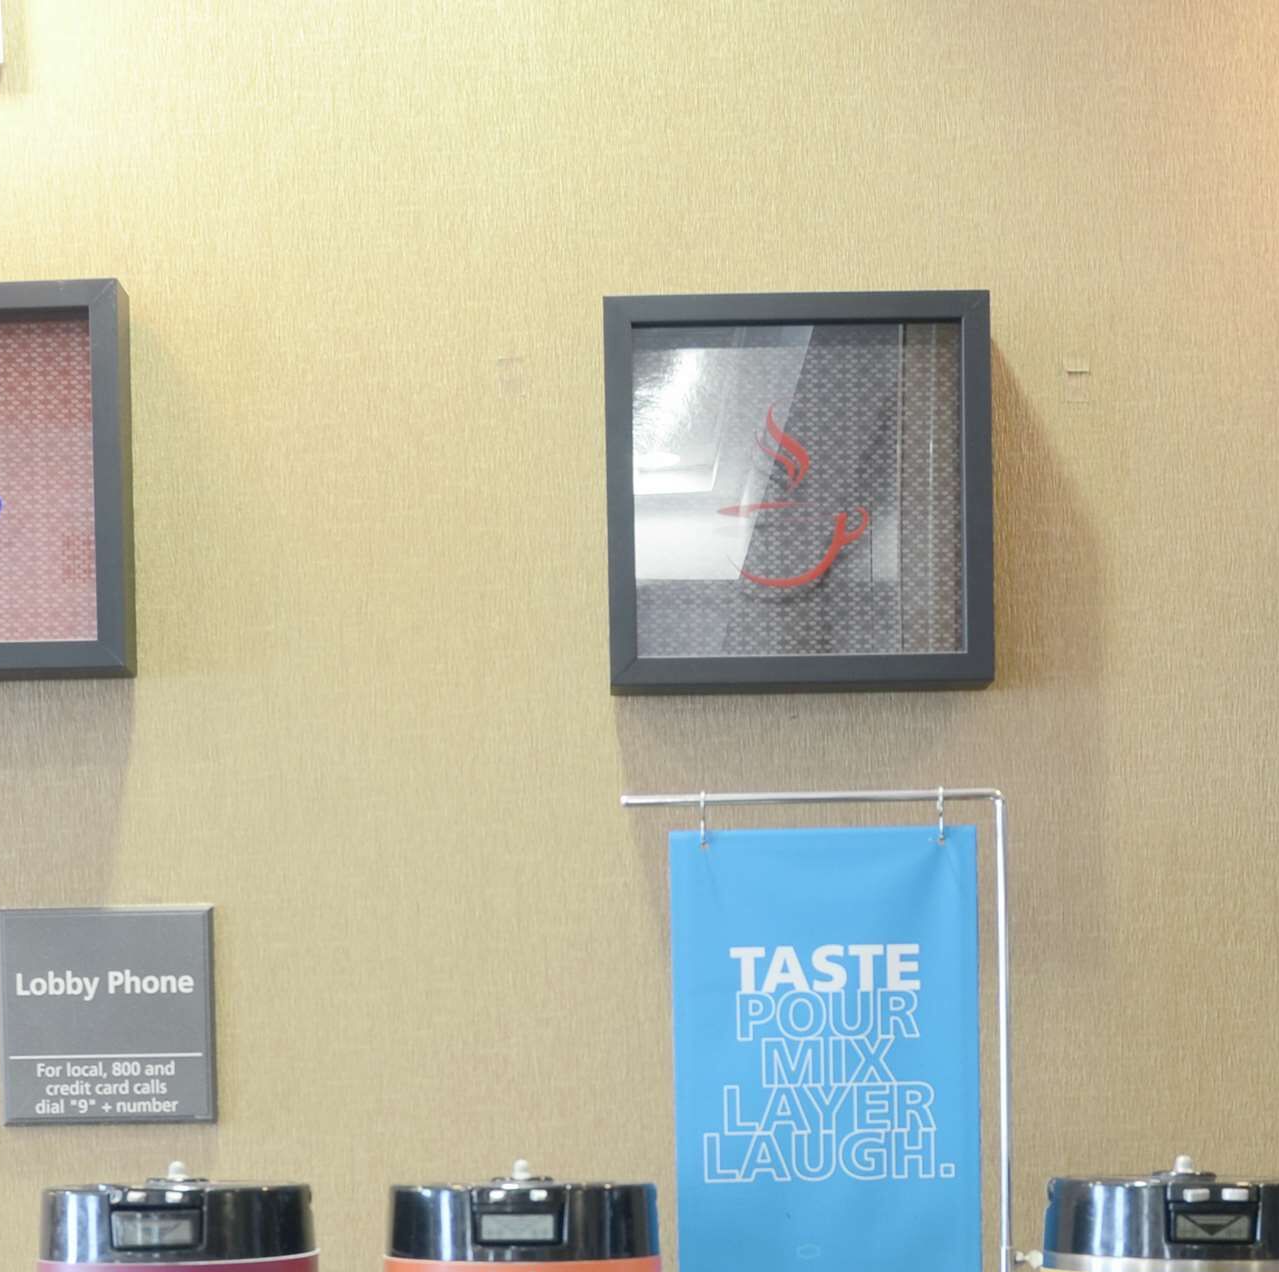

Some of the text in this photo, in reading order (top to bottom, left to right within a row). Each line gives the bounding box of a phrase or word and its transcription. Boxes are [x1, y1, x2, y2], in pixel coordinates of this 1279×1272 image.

[15, 969, 194, 1000] Lobby Phone
[729, 943, 921, 993] TASTE
[736, 988, 920, 1040] POUR
[36, 1060, 176, 1079] For local, 800 and
[761, 1036, 896, 1088] MIX
[35, 1099, 65, 1114] dial
[101, 1101, 112, 1113] +
[116, 1098, 179, 1113] number
[45, 1079, 168, 1096] credit card calls
[723, 1081, 936, 1135] LAYER
[704, 1128, 956, 1183] LAUGH.
